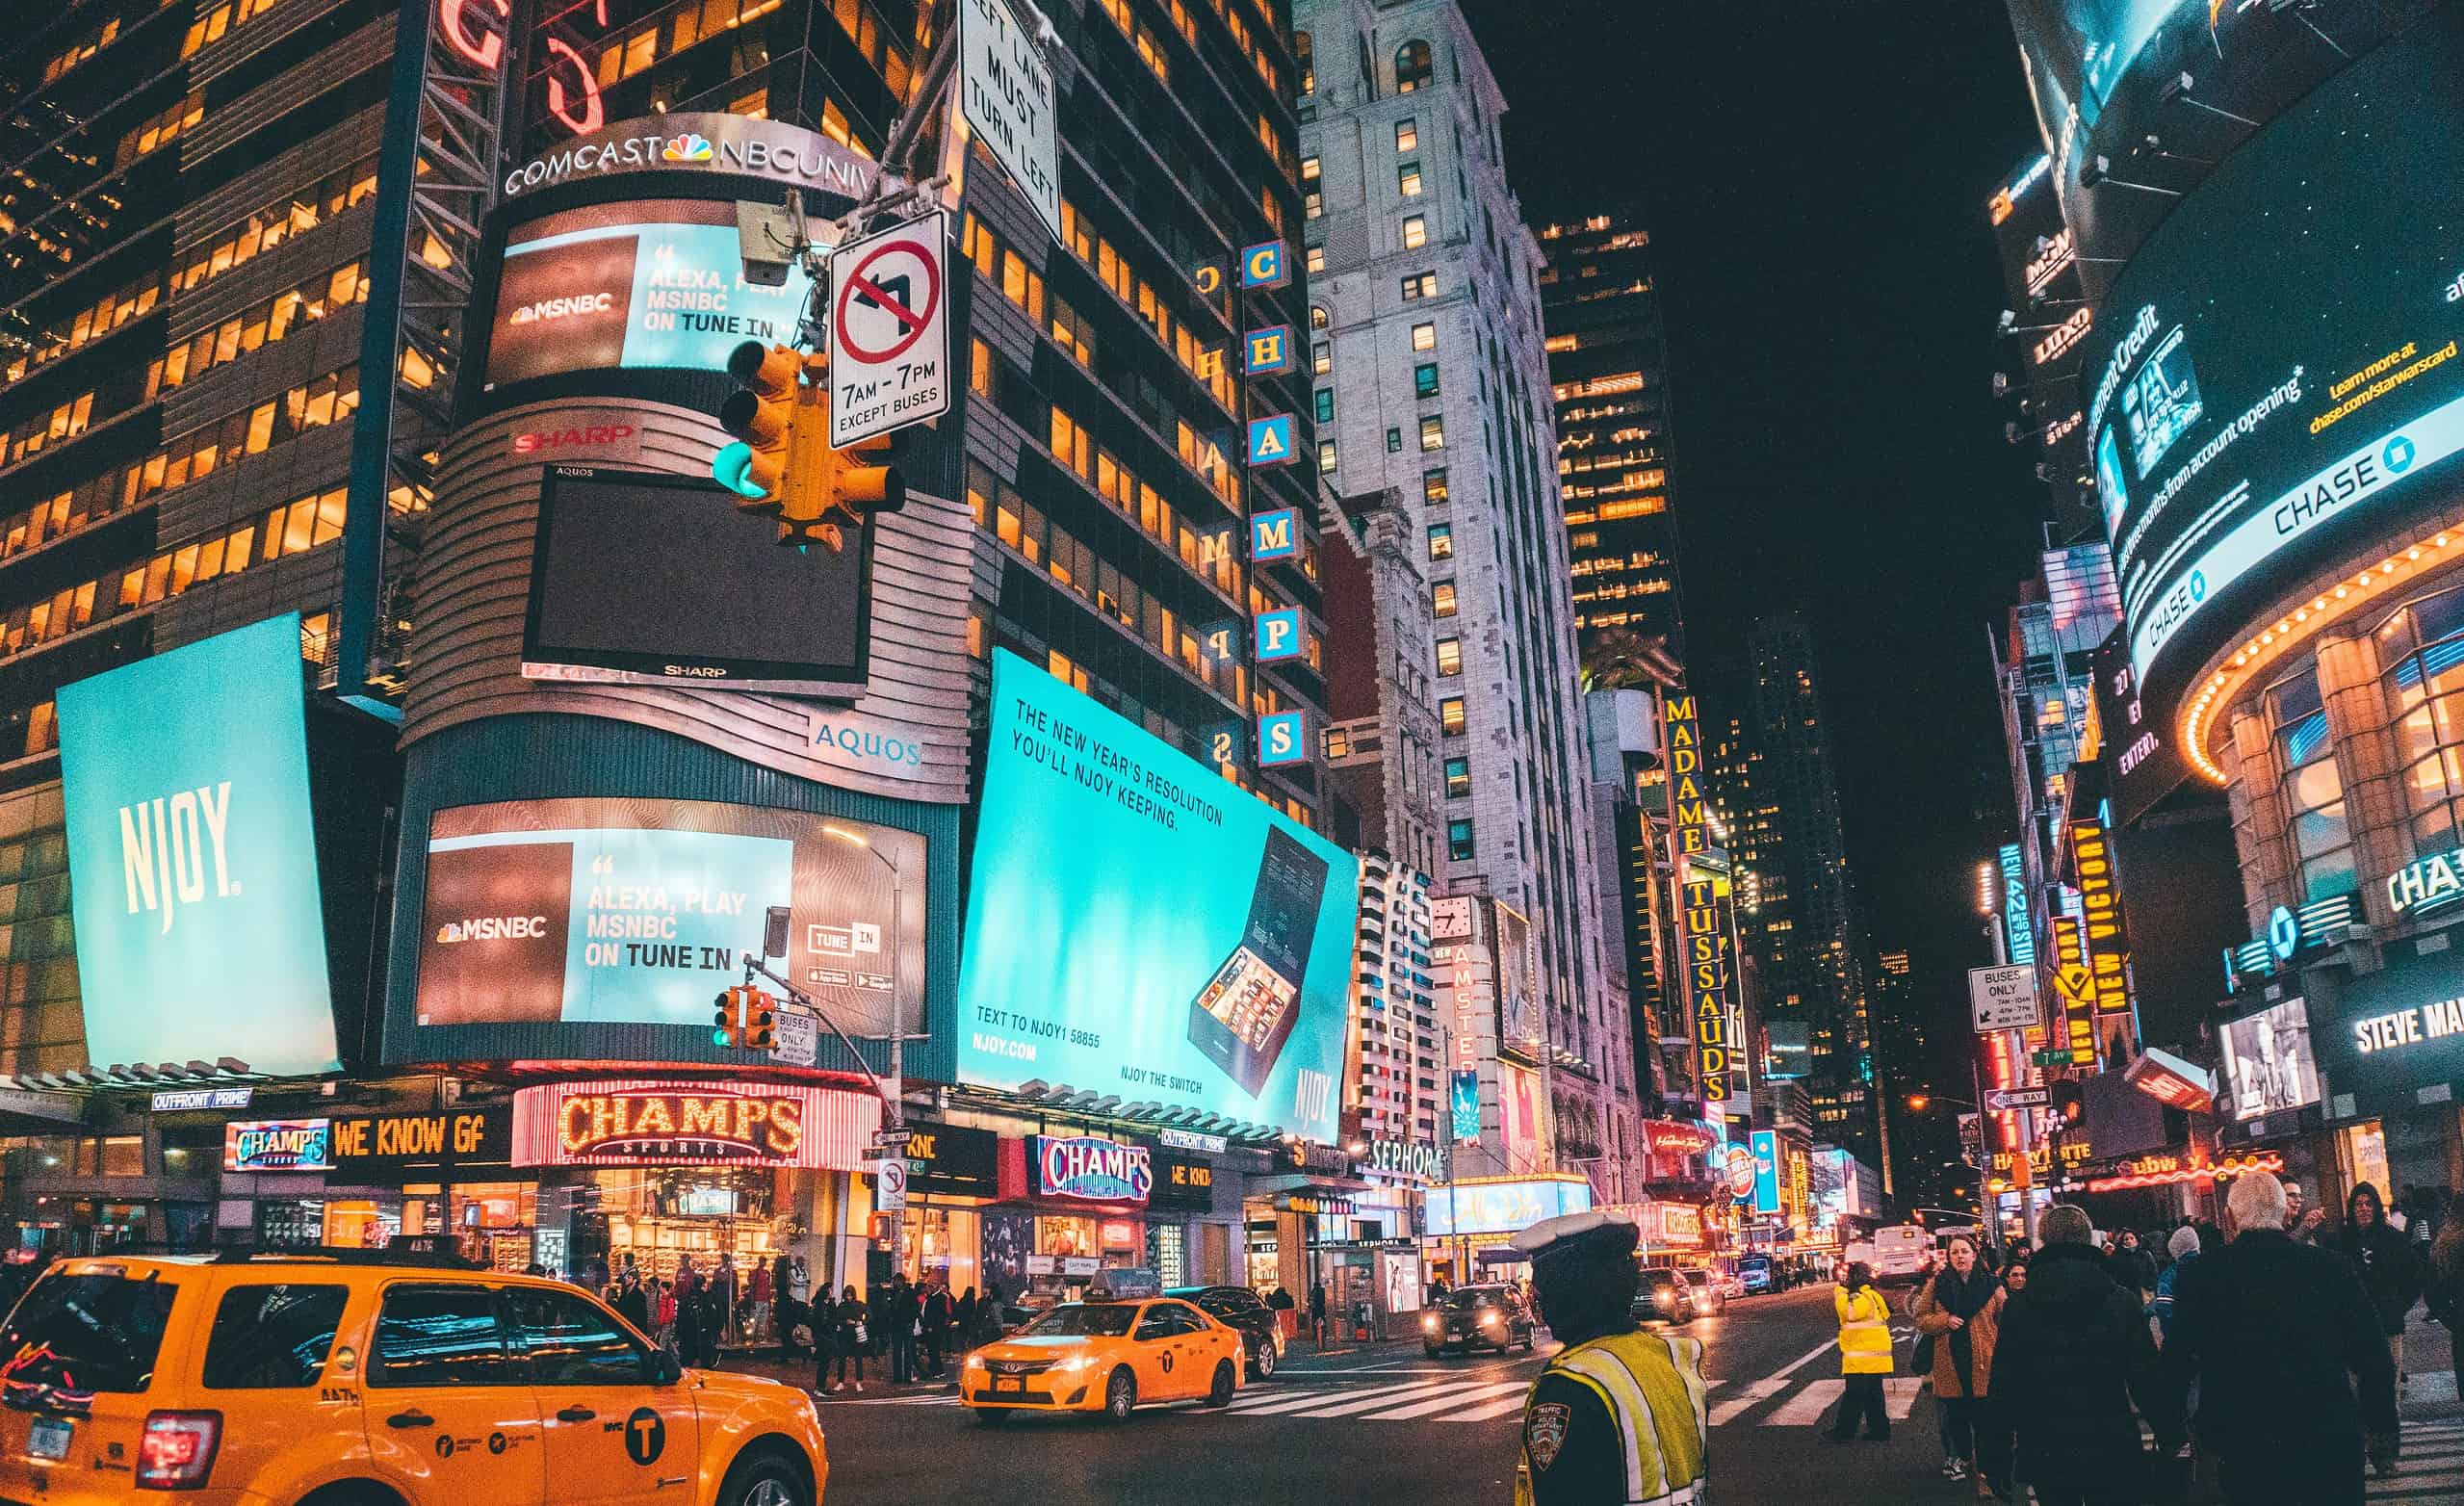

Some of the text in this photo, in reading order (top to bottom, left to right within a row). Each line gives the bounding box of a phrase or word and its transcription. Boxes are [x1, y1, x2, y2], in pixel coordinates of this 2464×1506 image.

[973, 0, 1049, 110] EFT LANE
[987, 44, 1037, 137] MUST
[971, 76, 1053, 209] TURN LEFT
[505, 136, 662, 195] COMCAST
[648, 269, 728, 292] ALEXA,
[534, 292, 613, 321] MSNBC
[646, 291, 728, 311] MSNBC
[644, 312, 675, 331] ON
[682, 313, 740, 334] TUNE
[2116, 303, 2160, 375] Credit
[842, 381, 877, 409] 7AM
[896, 360, 936, 390] 7PM
[2329, 341, 2418, 401] Learn more at
[840, 387, 938, 431] EXCEPT BUSES
[514, 425, 634, 454] SHARP
[555, 467, 594, 478] AQUOS
[2166, 465, 2192, 501] from
[2189, 422, 2240, 475] account
[2274, 454, 2379, 535] CHASE
[2149, 584, 2191, 648] CHASE
[663, 664, 728, 678] SHARP
[816, 723, 921, 766] AQUOS
[1012, 728, 1180, 832] YOU'LL NJOY KEEPING.
[1016, 699, 1223, 827] THE NEW YEAR'S RESOLUTION
[1666, 696, 1704, 853] MADAME
[118, 781, 242, 937] NJOY.
[2002, 845, 2022, 878] NEW
[2387, 848, 2464, 913] CHA
[587, 885, 747, 916] ALEXA, PLAY
[2074, 826, 2127, 1010] NEW VICTORY
[462, 916, 548, 942] MSNBC
[586, 914, 677, 940] MSNBC
[816, 931, 873, 949] TUNE IN
[584, 942, 619, 968] ON
[626, 944, 692, 969] TUNE
[1984, 970, 2021, 984] BUSES
[1988, 984, 2017, 997] ONLY
[2055, 922, 2094, 1064] NEW VTORY
[779, 1015, 810, 1030] BUSES
[781, 1032, 805, 1046] ONLY
[977, 1005, 1101, 1049] TEXT TO NJOY1 58855
[2355, 996, 2464, 1054] STEVE MA
[972, 1031, 1037, 1063] NJOY.COM
[2043, 1052, 2050, 1065] 7
[1121, 1064, 1203, 1095] NJOY THE SWITCH
[154, 1090, 248, 1108] OUTFRONT PRIME
[1996, 1092, 2042, 1105] ONE WAY
[334, 1120, 372, 1156] WE
[376, 1116, 447, 1155] KNOW
[558, 1097, 802, 1154] CHAMPS
[1163, 1130, 1203, 1148] OUTFRONT
[236, 1130, 325, 1162] CHAMPS
[623, 1141, 725, 1155] SPORTS
[1372, 1139, 1444, 1176] SEPHOR
[1046, 1142, 1154, 1194] CHAMPS
[1171, 1165, 1186, 1184] WE
[634, 1418, 656, 1457] T
